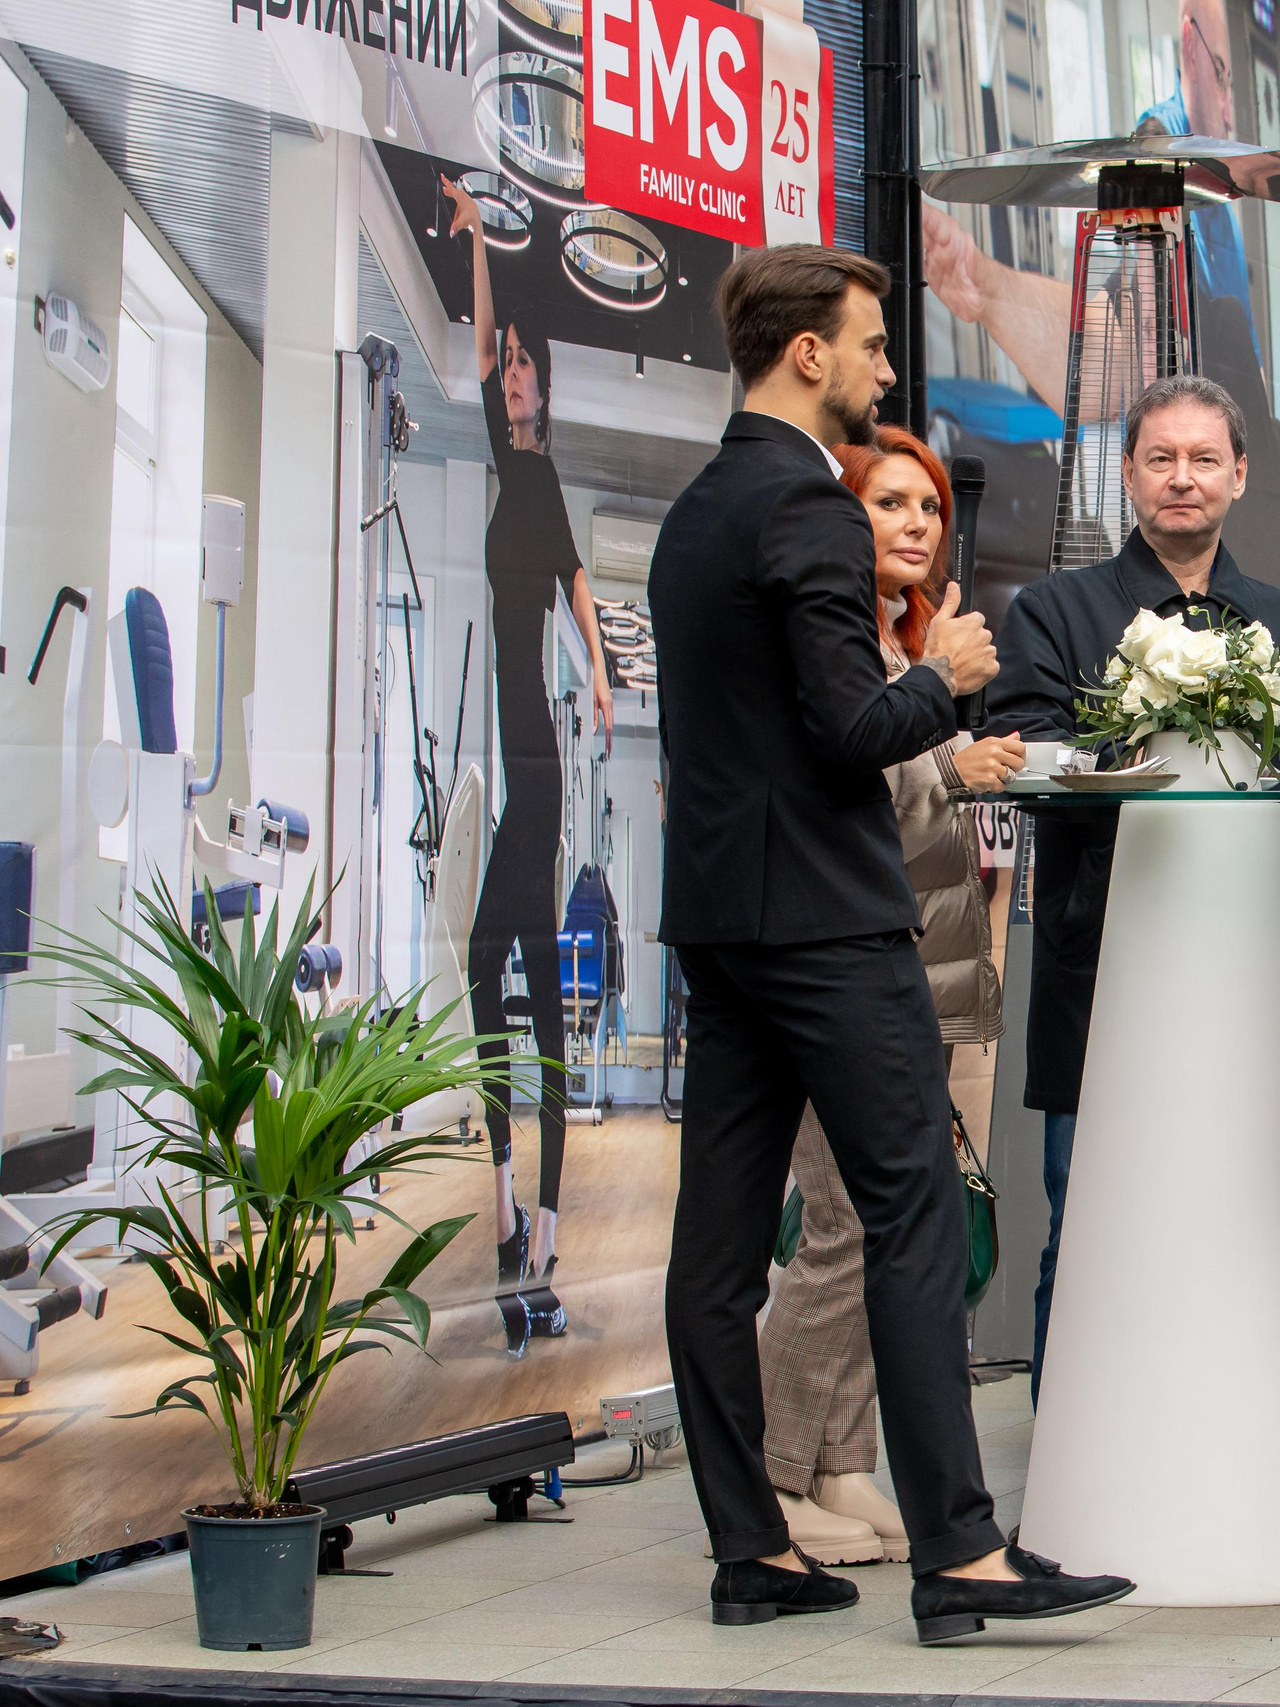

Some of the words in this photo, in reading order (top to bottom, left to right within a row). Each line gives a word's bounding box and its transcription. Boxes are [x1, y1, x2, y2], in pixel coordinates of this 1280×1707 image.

[231, 0, 468, 77] ЖЕНИИ
[591, 0, 748, 172] EMS
[770, 80, 810, 164] 25
[640, 163, 695, 207] FAMILY
[698, 183, 746, 223] CLINIC
[774, 180, 806, 219] ЛЕТ
